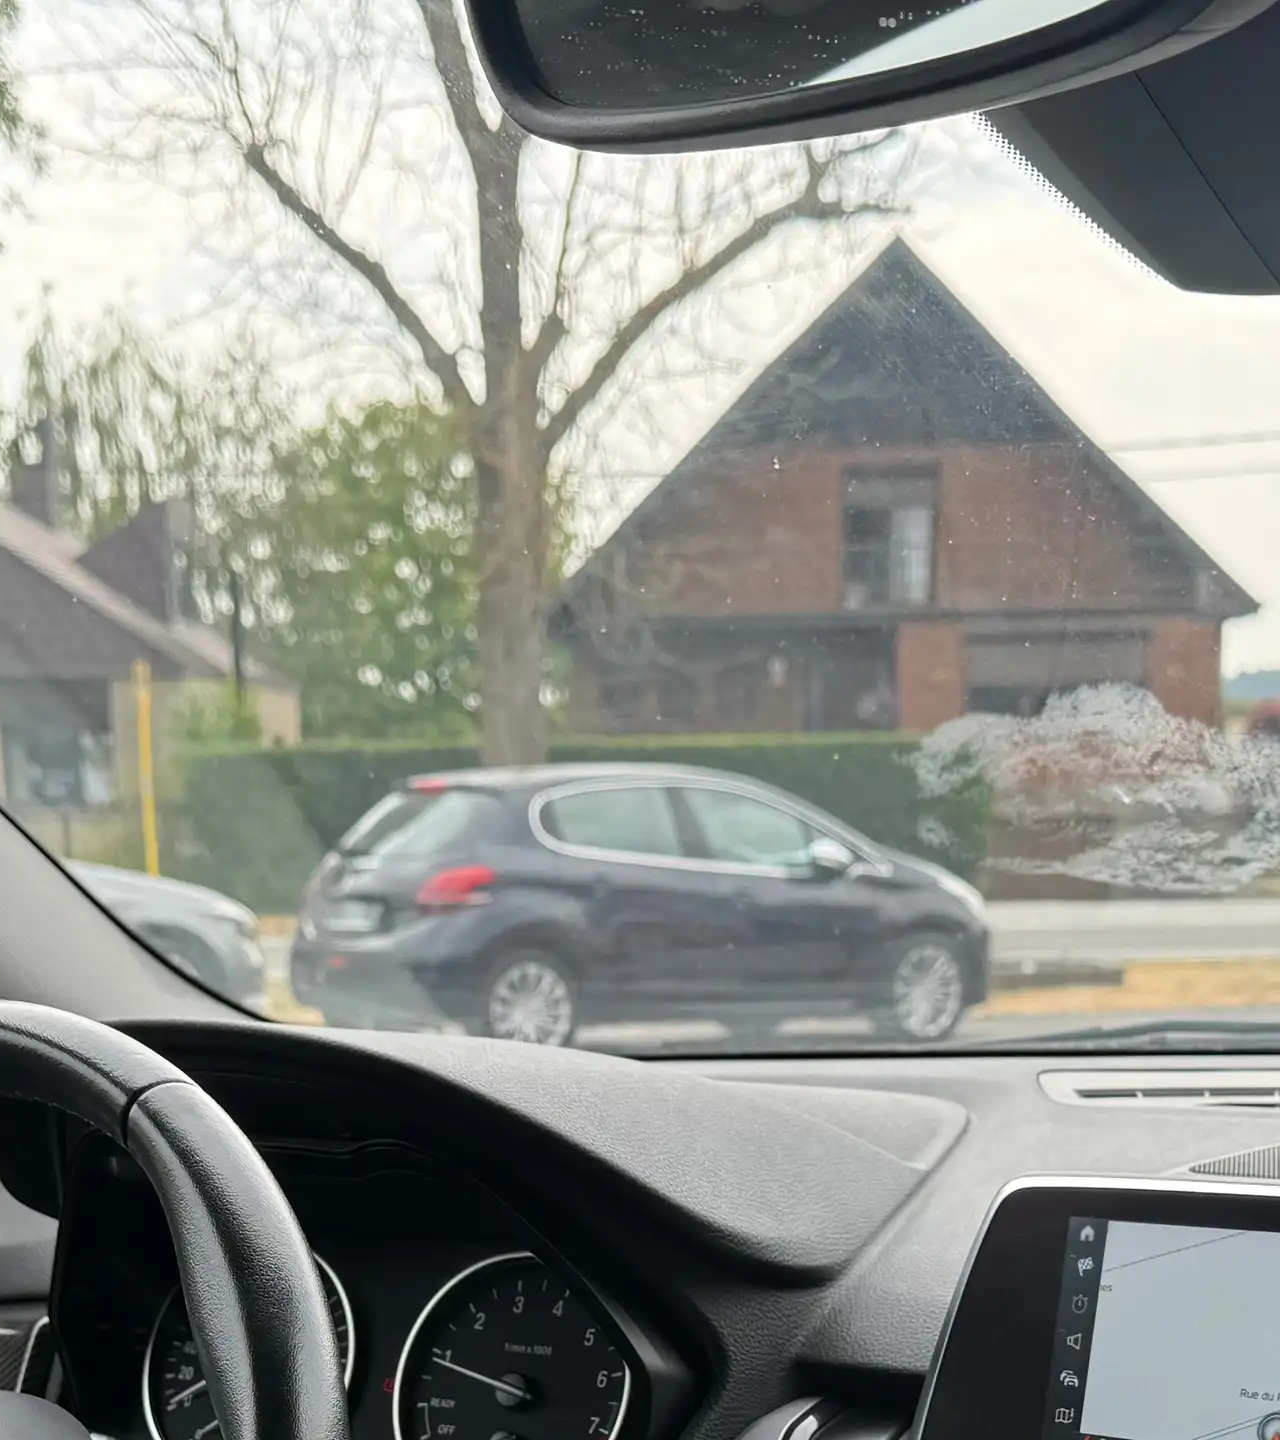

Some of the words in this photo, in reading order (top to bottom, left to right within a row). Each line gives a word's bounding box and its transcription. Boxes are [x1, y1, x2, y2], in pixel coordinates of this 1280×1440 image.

[512, 1296, 525, 1314] 3
[552, 1300, 564, 1317] 4
[473, 1312, 486, 1330] 2
[583, 1328, 596, 1346] 5
[178, 1365, 194, 1380] 20
[596, 1370, 609, 1388] 6
[429, 1397, 456, 1409] READY
[1240, 1388, 1260, 1400] Rue
[1261, 1391, 1274, 1402] du
[437, 1423, 457, 1435] OFF
[588, 1416, 600, 1435] 7
